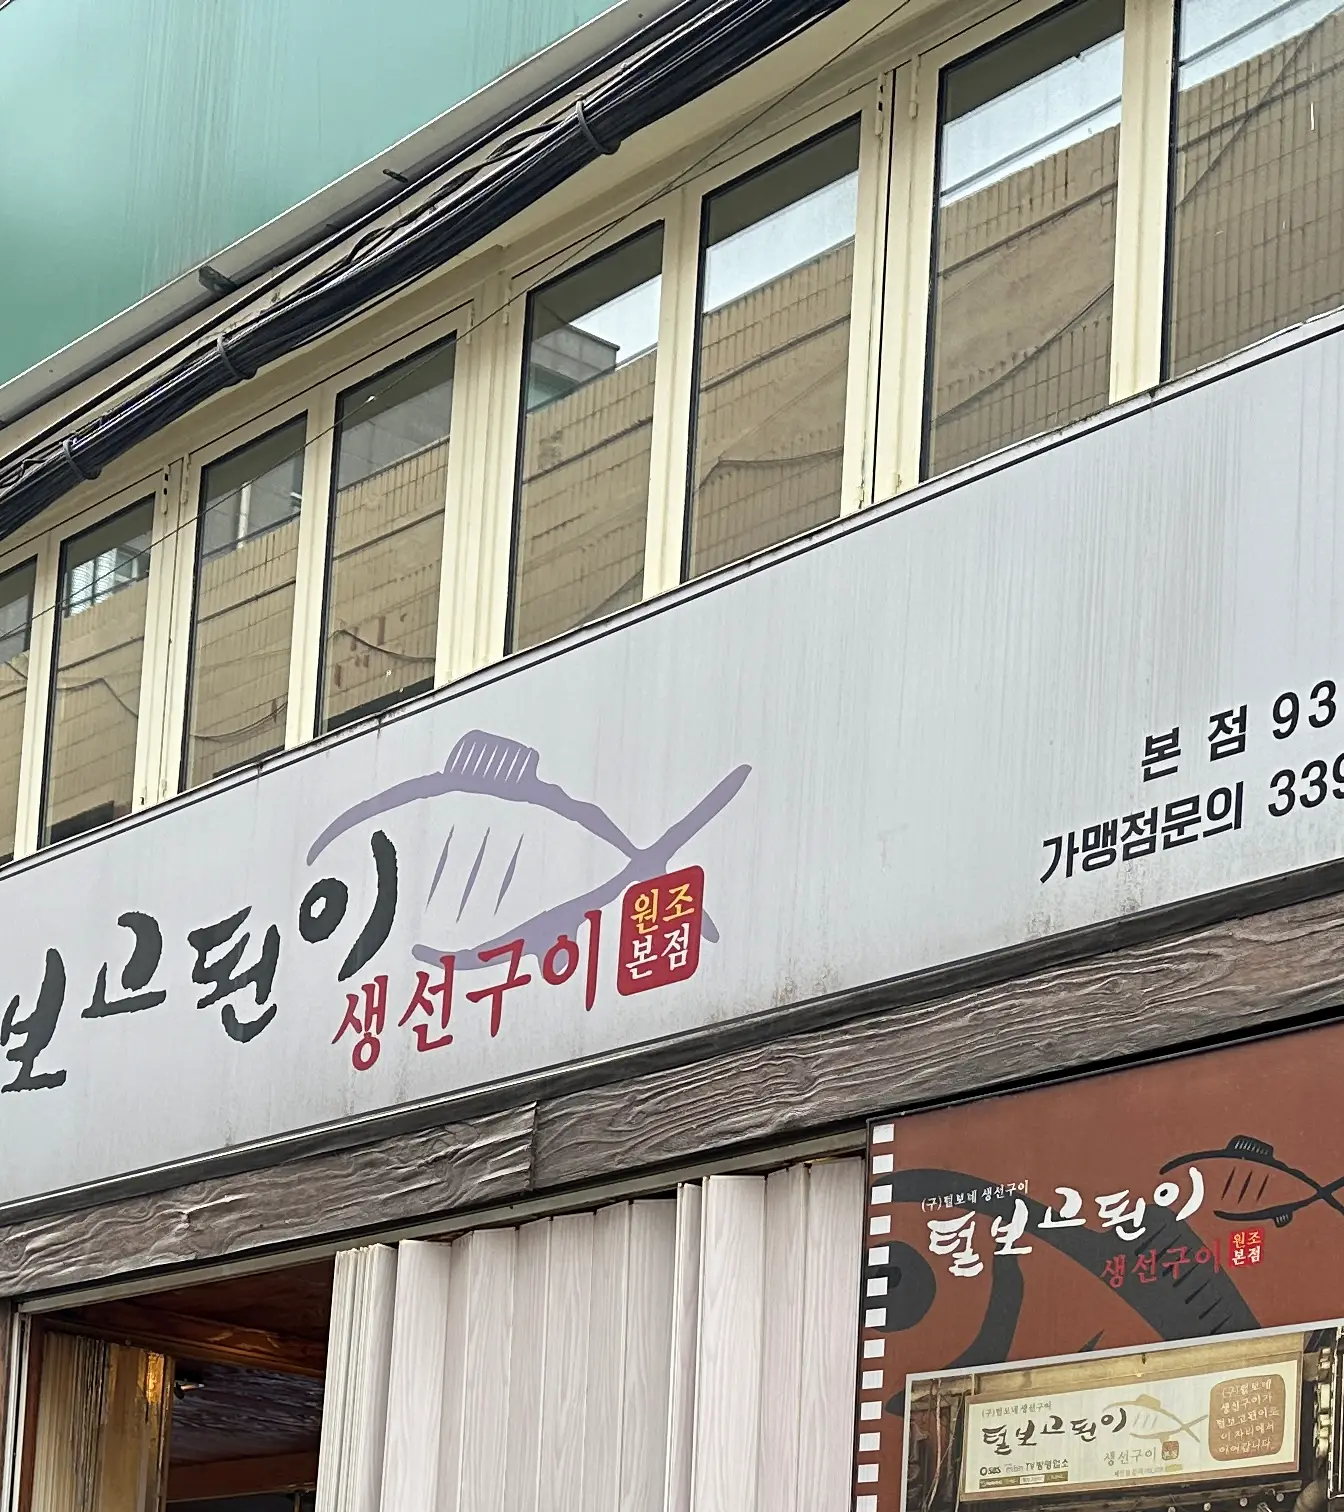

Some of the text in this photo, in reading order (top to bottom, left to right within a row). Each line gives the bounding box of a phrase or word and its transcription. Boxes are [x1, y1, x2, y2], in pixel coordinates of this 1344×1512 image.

[1039, 781, 1244, 884] 가맹점문의
[630, 882, 695, 935] 원조
[625, 922, 691, 980] 본점
[331, 907, 601, 1072] 생선구이
[1101, 1237, 1222, 1289] 생선구이
[1232, 1246, 1261, 1265] 본점
[1233, 1231, 1262, 1247] 원조
